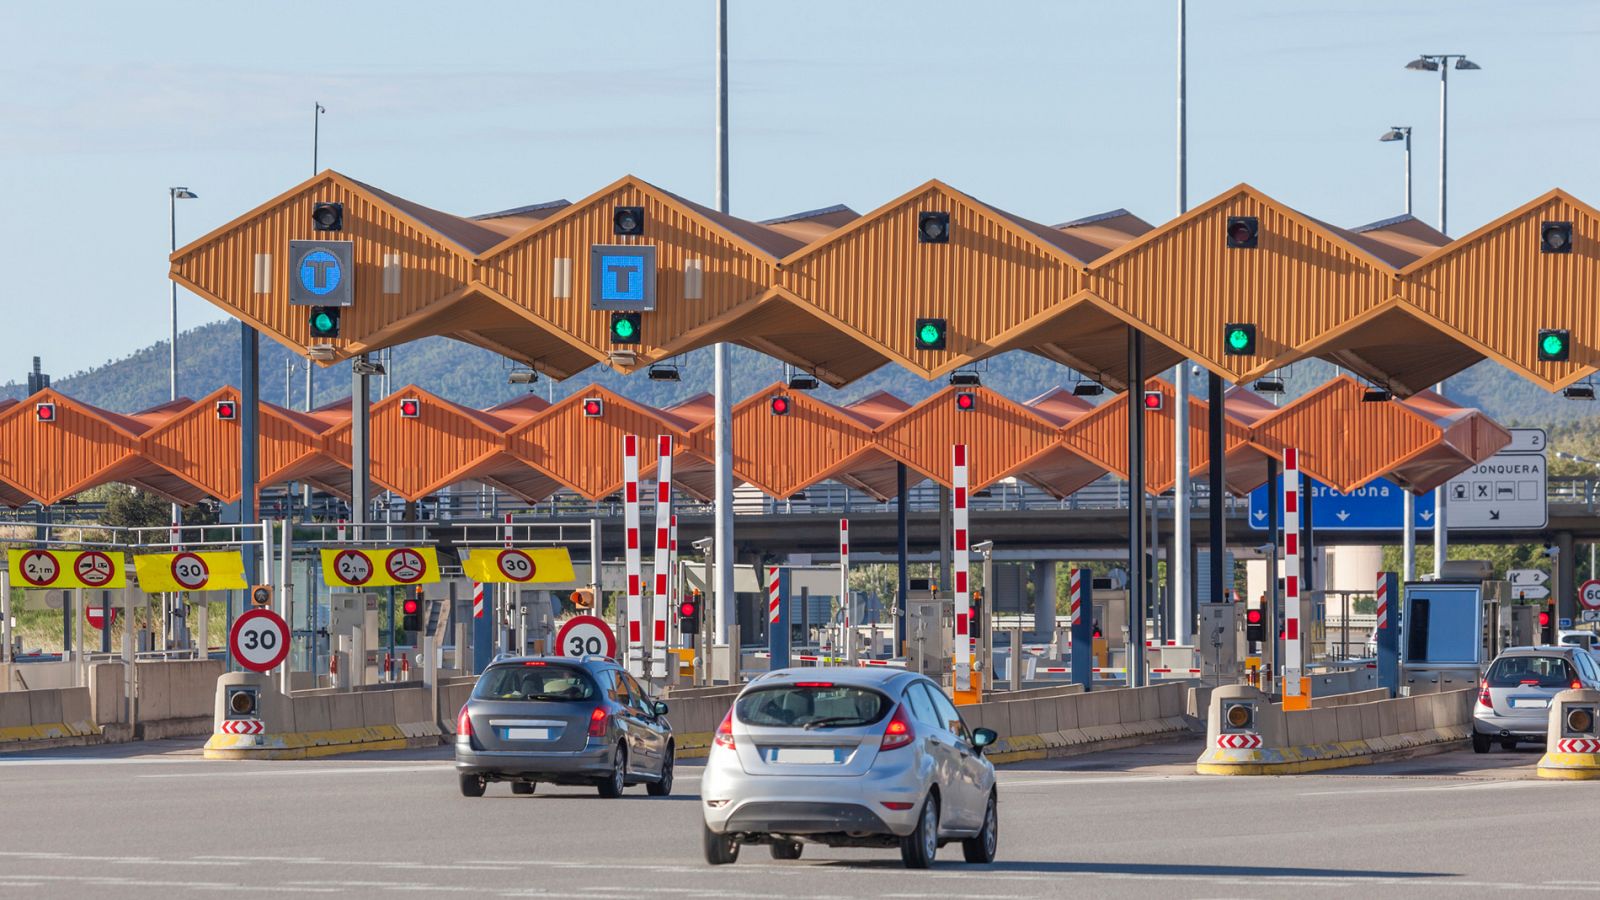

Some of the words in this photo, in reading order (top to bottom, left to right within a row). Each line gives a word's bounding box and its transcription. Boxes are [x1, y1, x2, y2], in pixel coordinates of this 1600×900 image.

[306, 260, 335, 288] T
[608, 265, 638, 293] T
[1532, 436, 1539, 445] 2
[1472, 465, 1539, 474] JONQUERA
[179, 565, 201, 576] 30
[505, 560, 528, 571] 30
[244, 630, 276, 650] 30
[570, 636, 601, 657] 30
